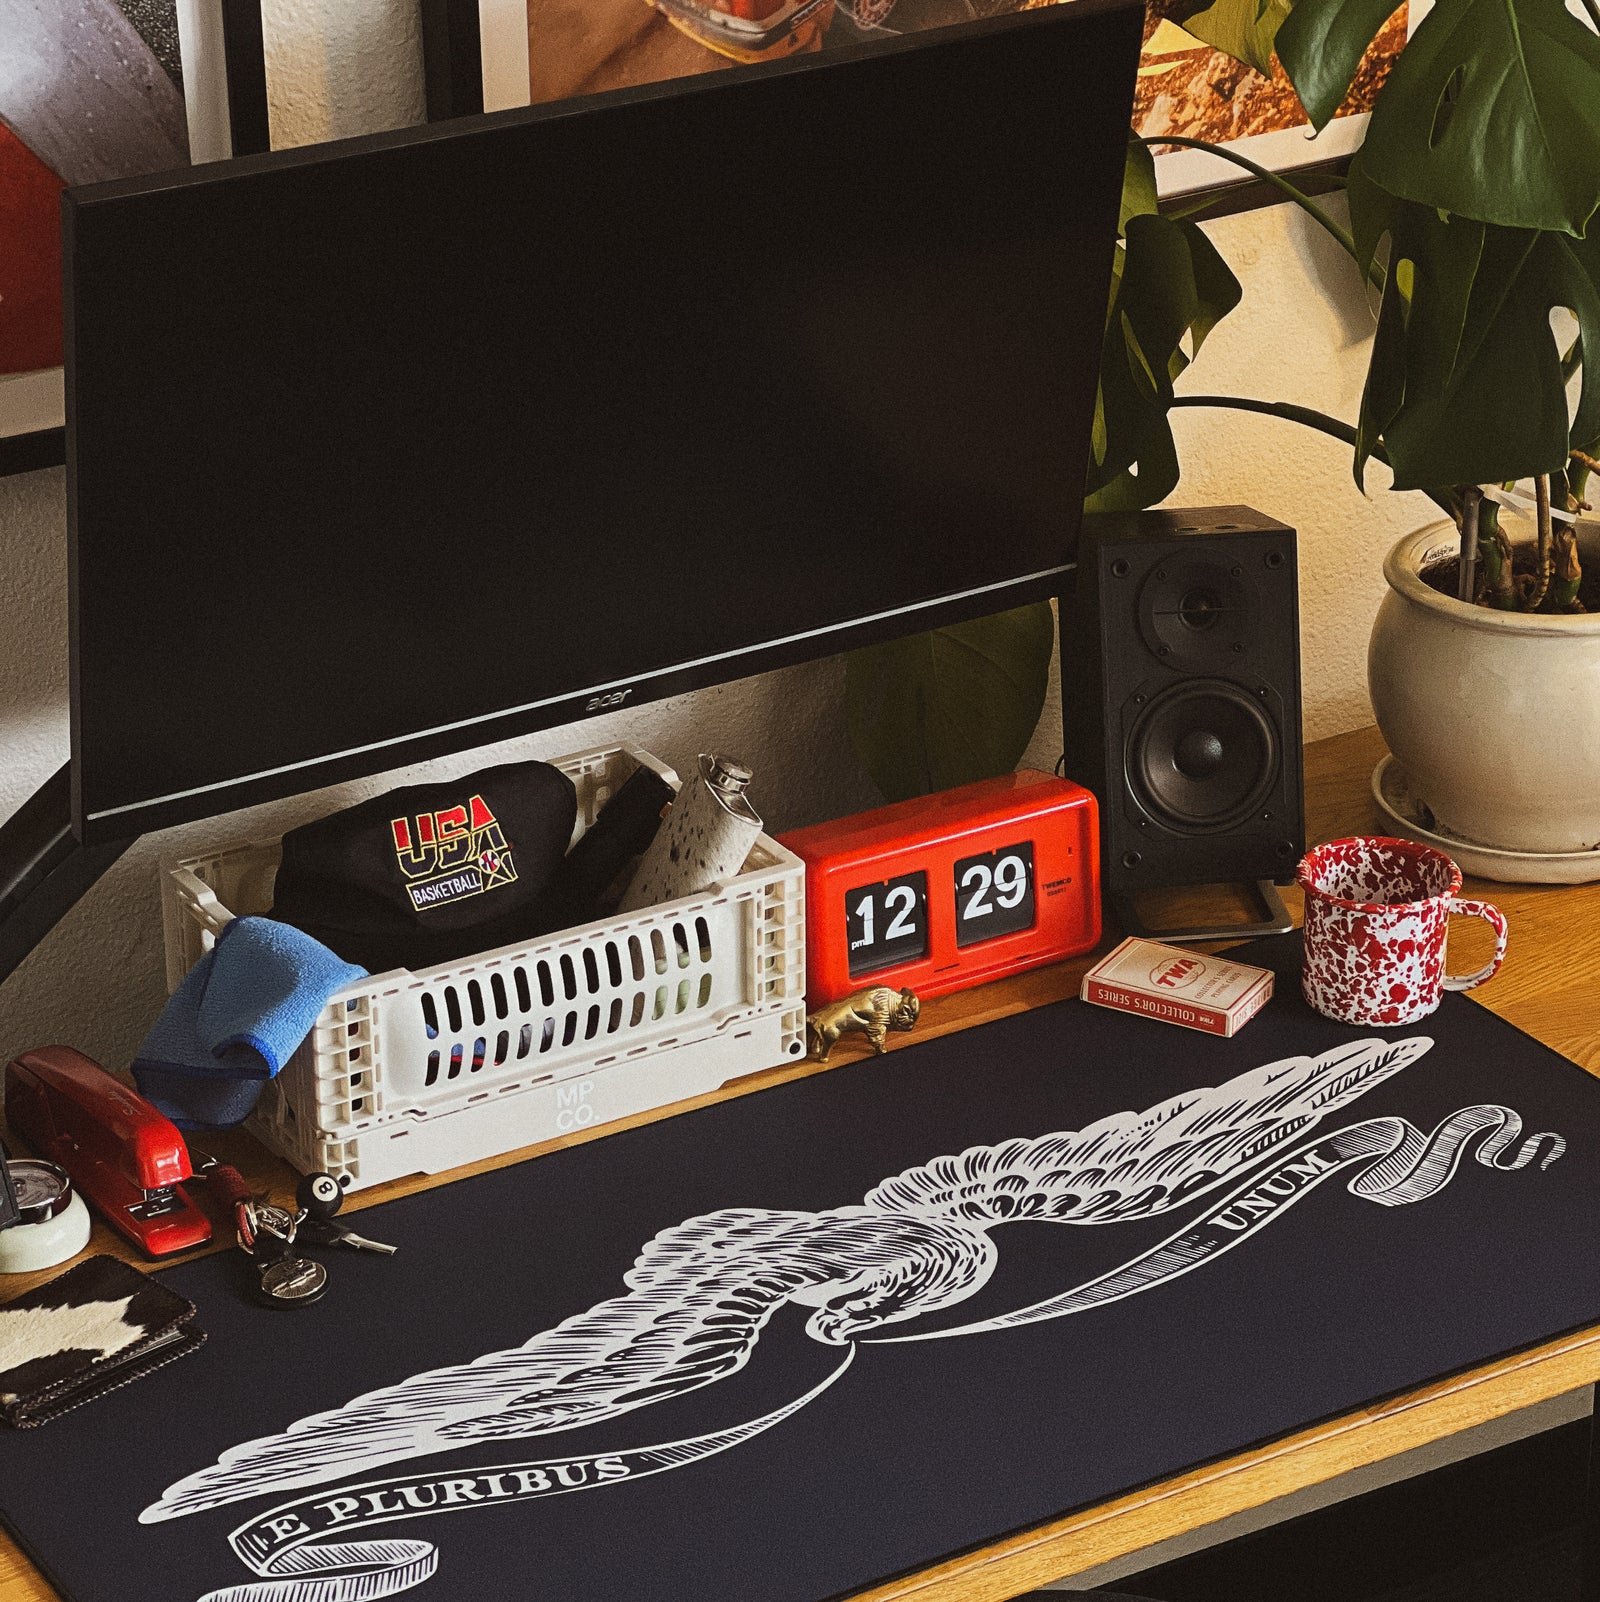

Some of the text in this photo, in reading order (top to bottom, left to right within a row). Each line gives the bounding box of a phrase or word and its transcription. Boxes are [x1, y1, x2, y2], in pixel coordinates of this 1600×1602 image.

[586, 689, 632, 711] acer
[391, 795, 508, 879] USA
[412, 872, 481, 905] BASKETBALL
[855, 855, 1027, 946] 12 29
[851, 939, 866, 951] pm
[1156, 958, 1199, 988] TWA
[1098, 988, 1131, 1005] SERIES
[1134, 997, 1196, 1022] COLLECTOR'S
[557, 1080, 594, 1108] MP
[556, 1104, 601, 1130] CO.
[319, 1181, 333, 1194] 8
[1207, 1149, 1341, 1231] UNUM
[260, 1456, 632, 1544] E PLURIBUS
